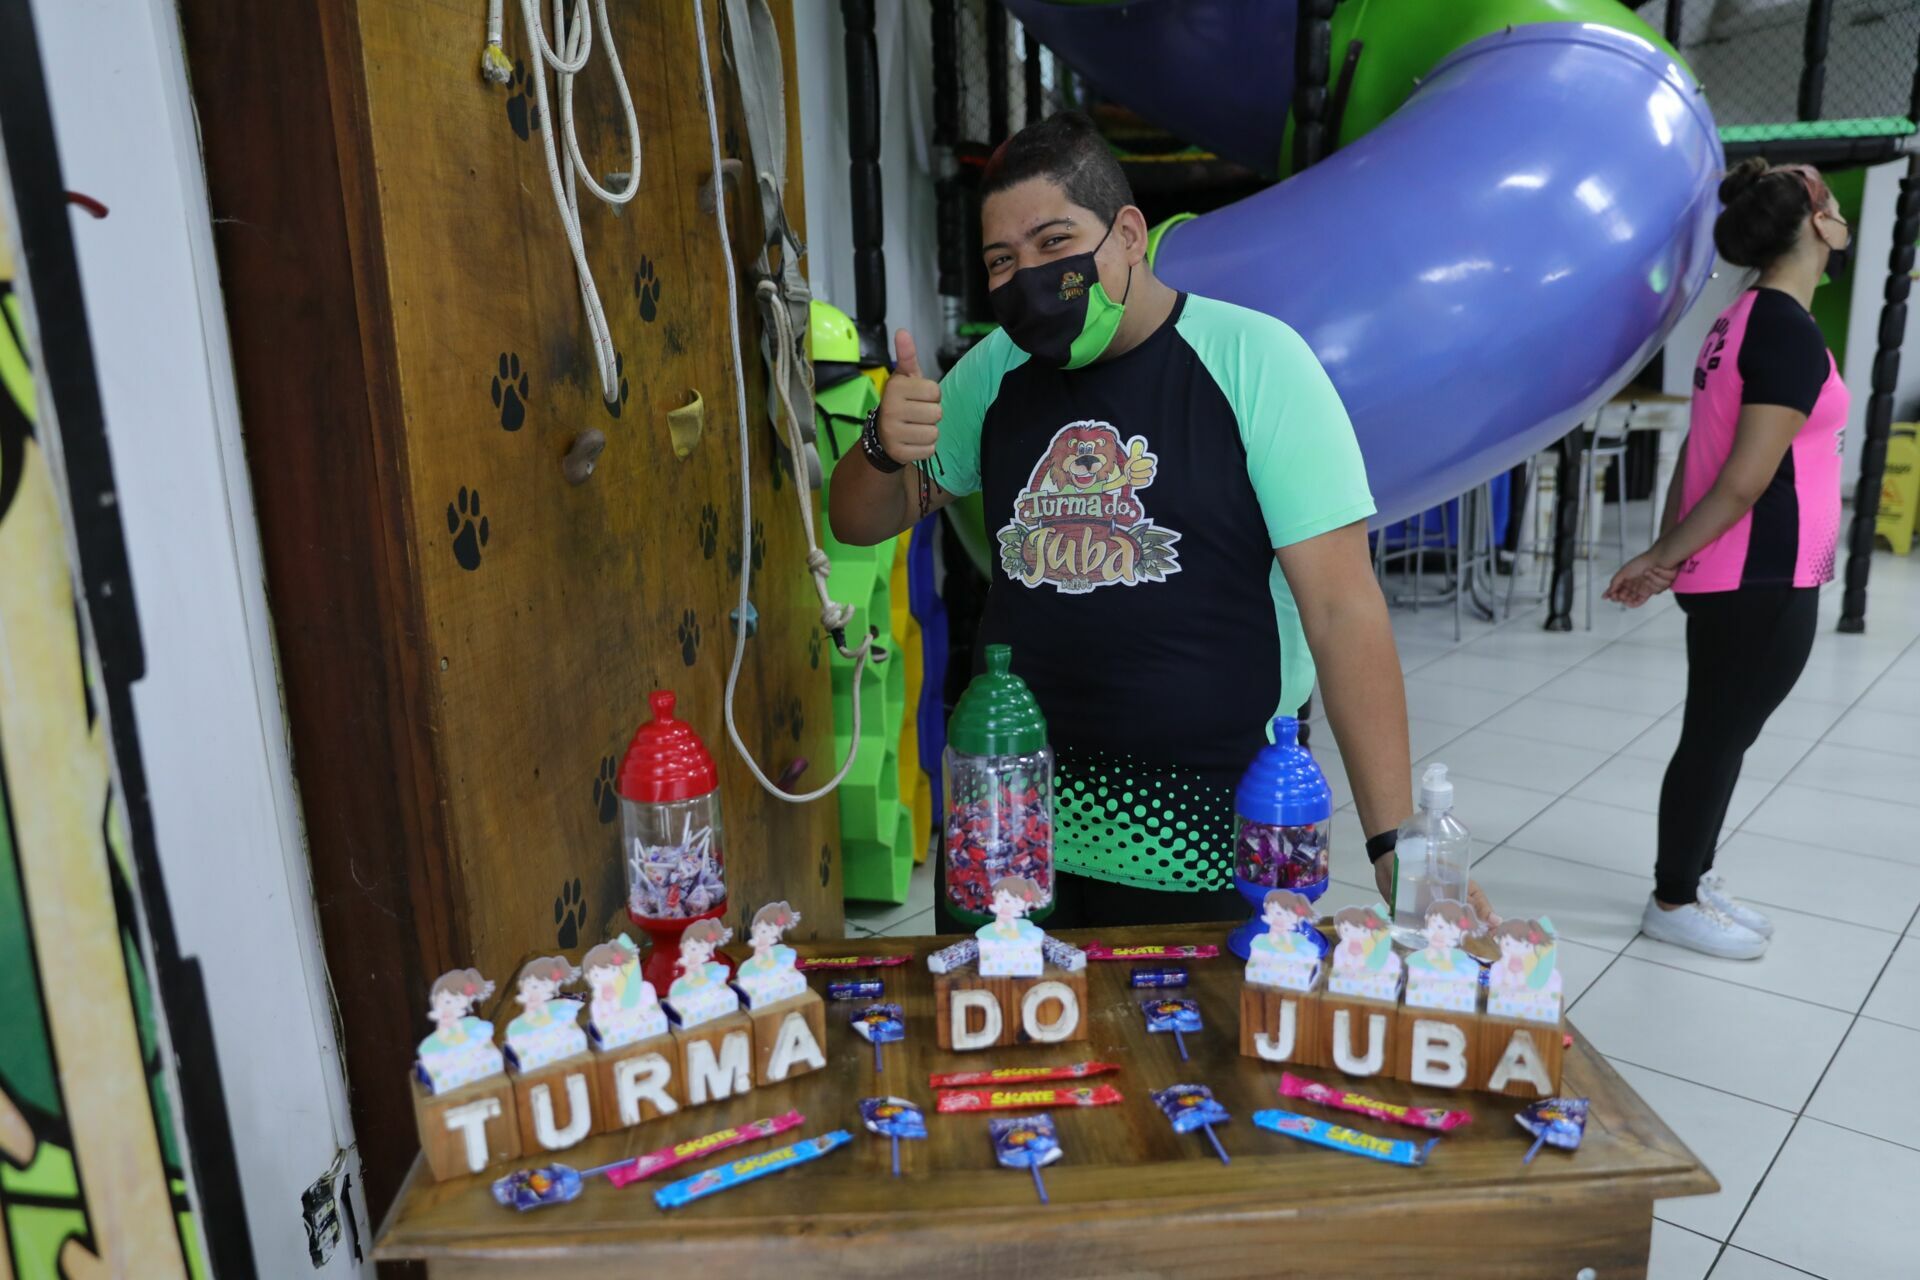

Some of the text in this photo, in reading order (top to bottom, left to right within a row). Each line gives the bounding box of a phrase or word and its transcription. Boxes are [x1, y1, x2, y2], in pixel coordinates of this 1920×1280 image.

[1023, 490, 1131, 518] Turma do
[1023, 527, 1135, 581] Juba
[1112, 946, 1165, 955] SKATE
[443, 981, 1553, 1174] TURMA DO JUBA
[990, 1089, 1056, 1106] SKATE
[1341, 1092, 1409, 1119] SKATE
[673, 1127, 739, 1157] SKATE
[1325, 1125, 1395, 1155] SKATE
[732, 1146, 798, 1175] SKATE
